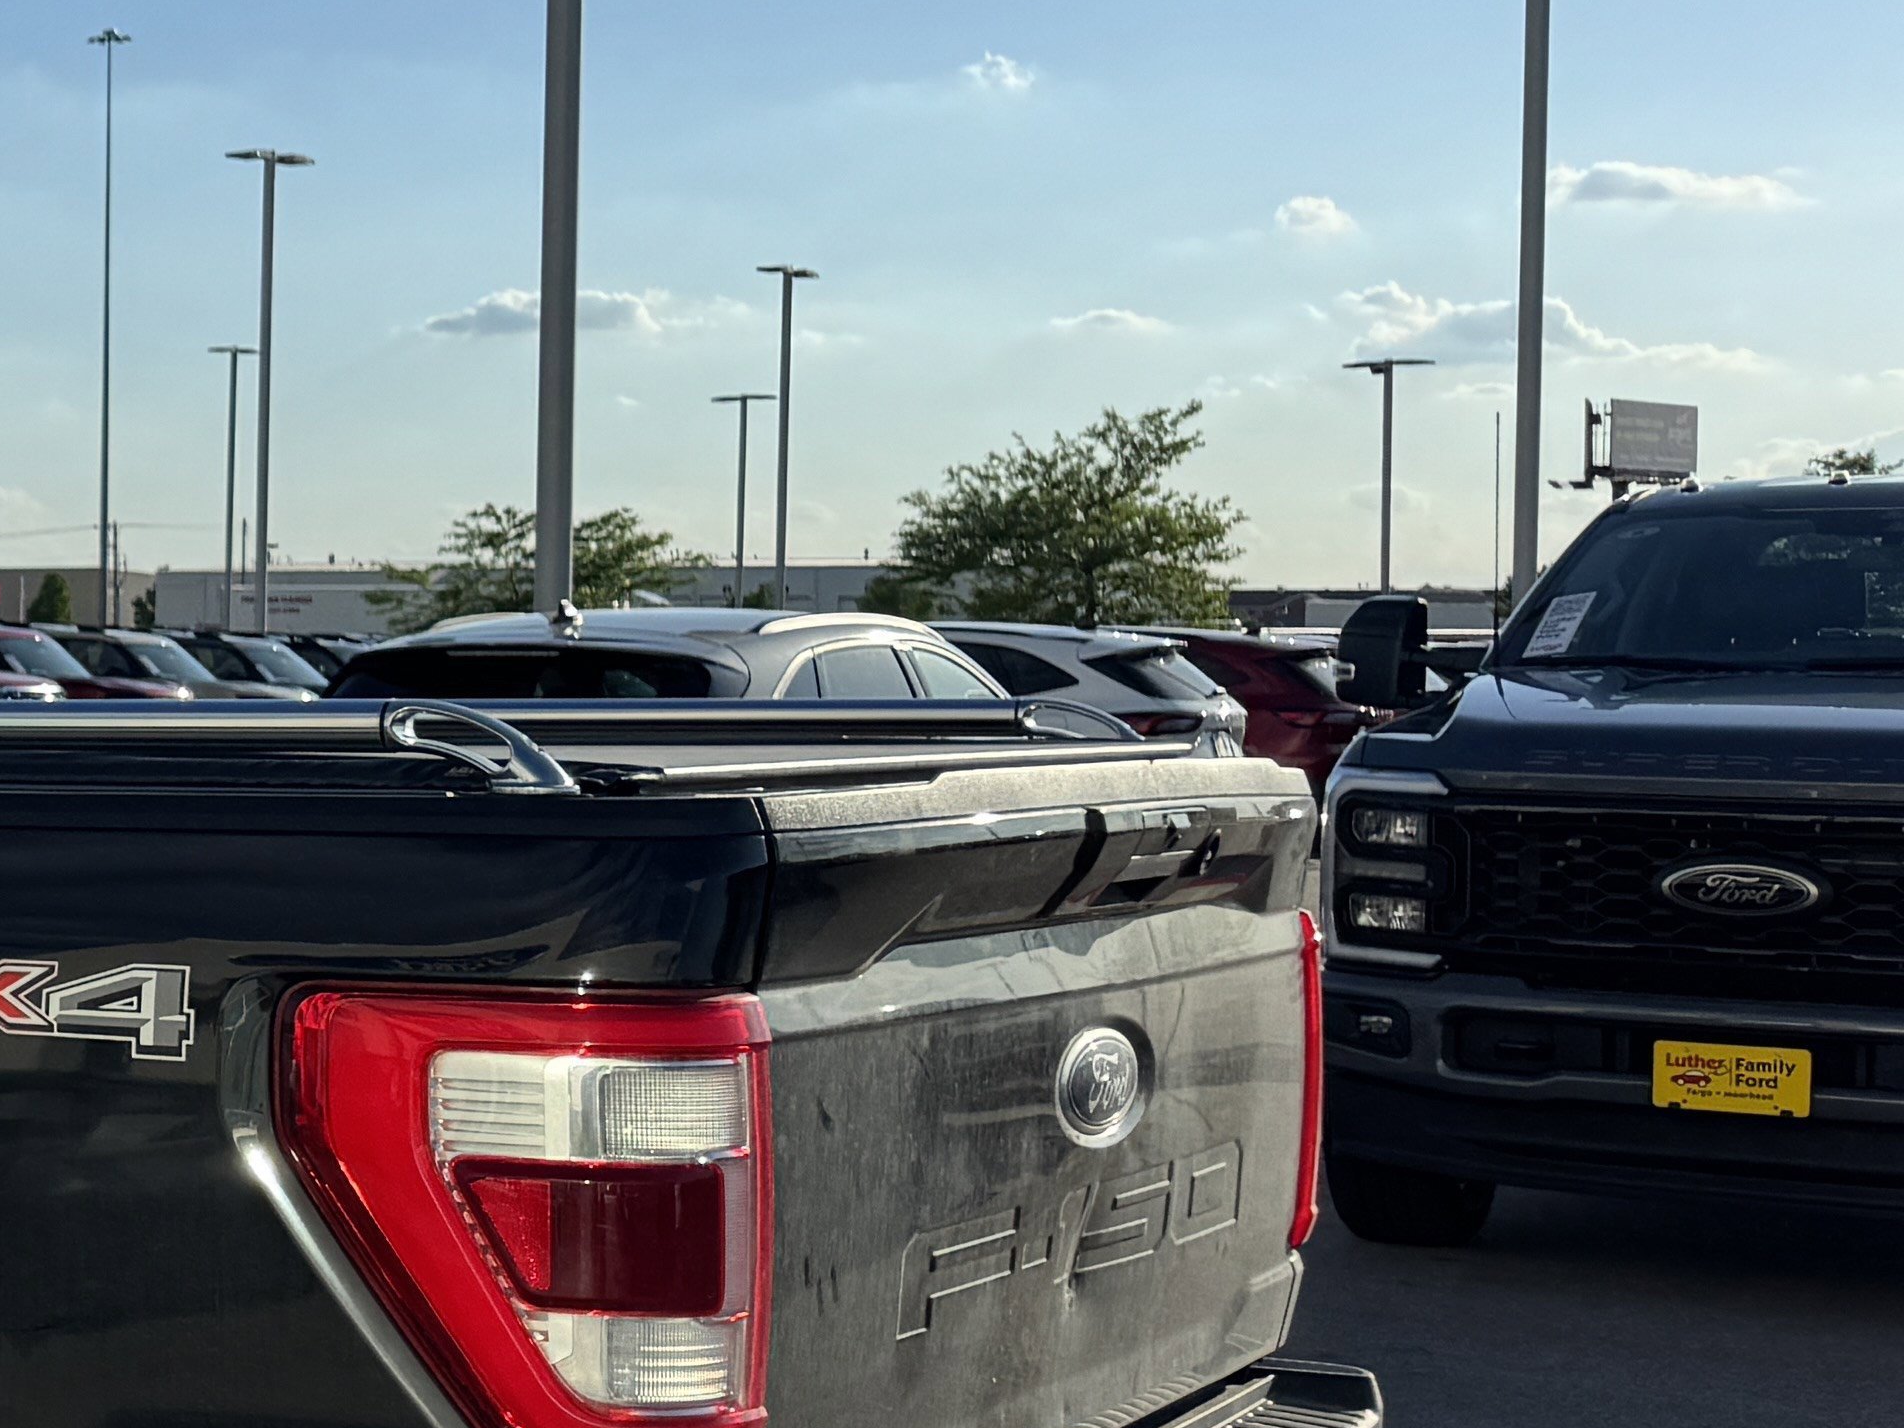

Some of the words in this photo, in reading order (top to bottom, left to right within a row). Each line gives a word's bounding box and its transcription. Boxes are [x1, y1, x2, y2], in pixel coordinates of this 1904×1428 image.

[1697, 874, 1780, 906] Ford
[1665, 1052, 1727, 1071] Luther
[1735, 1058, 1796, 1077] Family
[1088, 1052, 1130, 1114] Ford
[1735, 1074, 1779, 1089] Ford
[895, 1138, 1242, 1341] F-150
